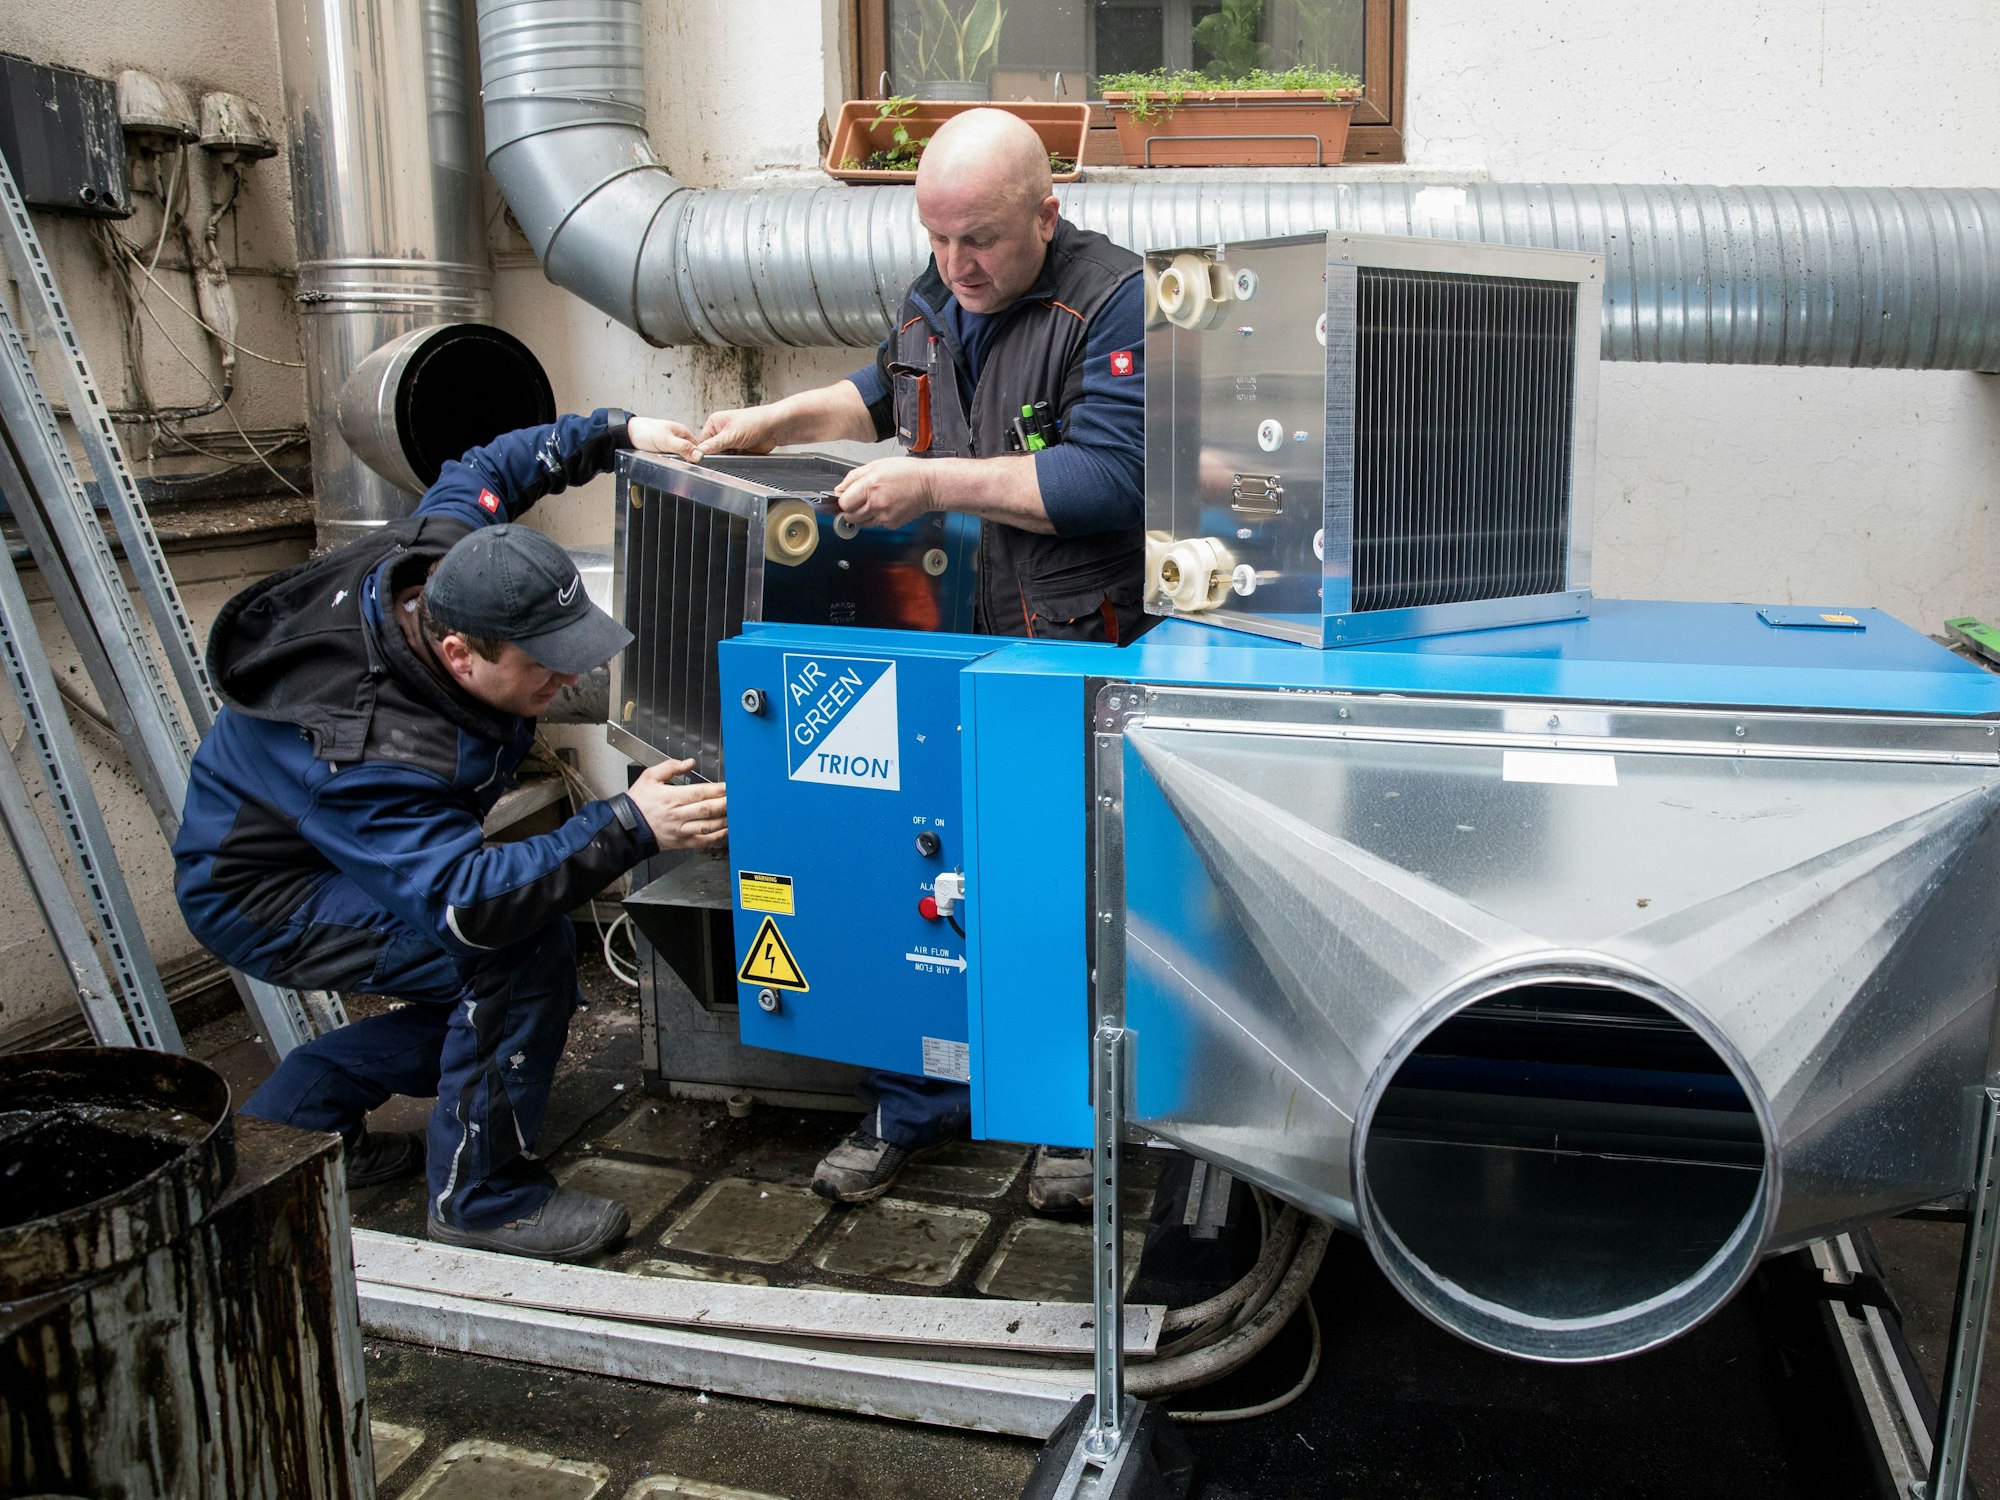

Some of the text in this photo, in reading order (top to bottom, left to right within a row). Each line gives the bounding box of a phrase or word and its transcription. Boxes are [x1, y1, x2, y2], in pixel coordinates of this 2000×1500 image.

[789, 661, 828, 707] AIR
[794, 667, 863, 746] GREEN
[817, 753, 889, 779] TRION
[912, 815, 945, 828] OFF ON
[920, 882, 935, 890] ALA
[914, 945, 949, 957] AIR FLOW
[915, 963, 950, 975] AIR FLOW
